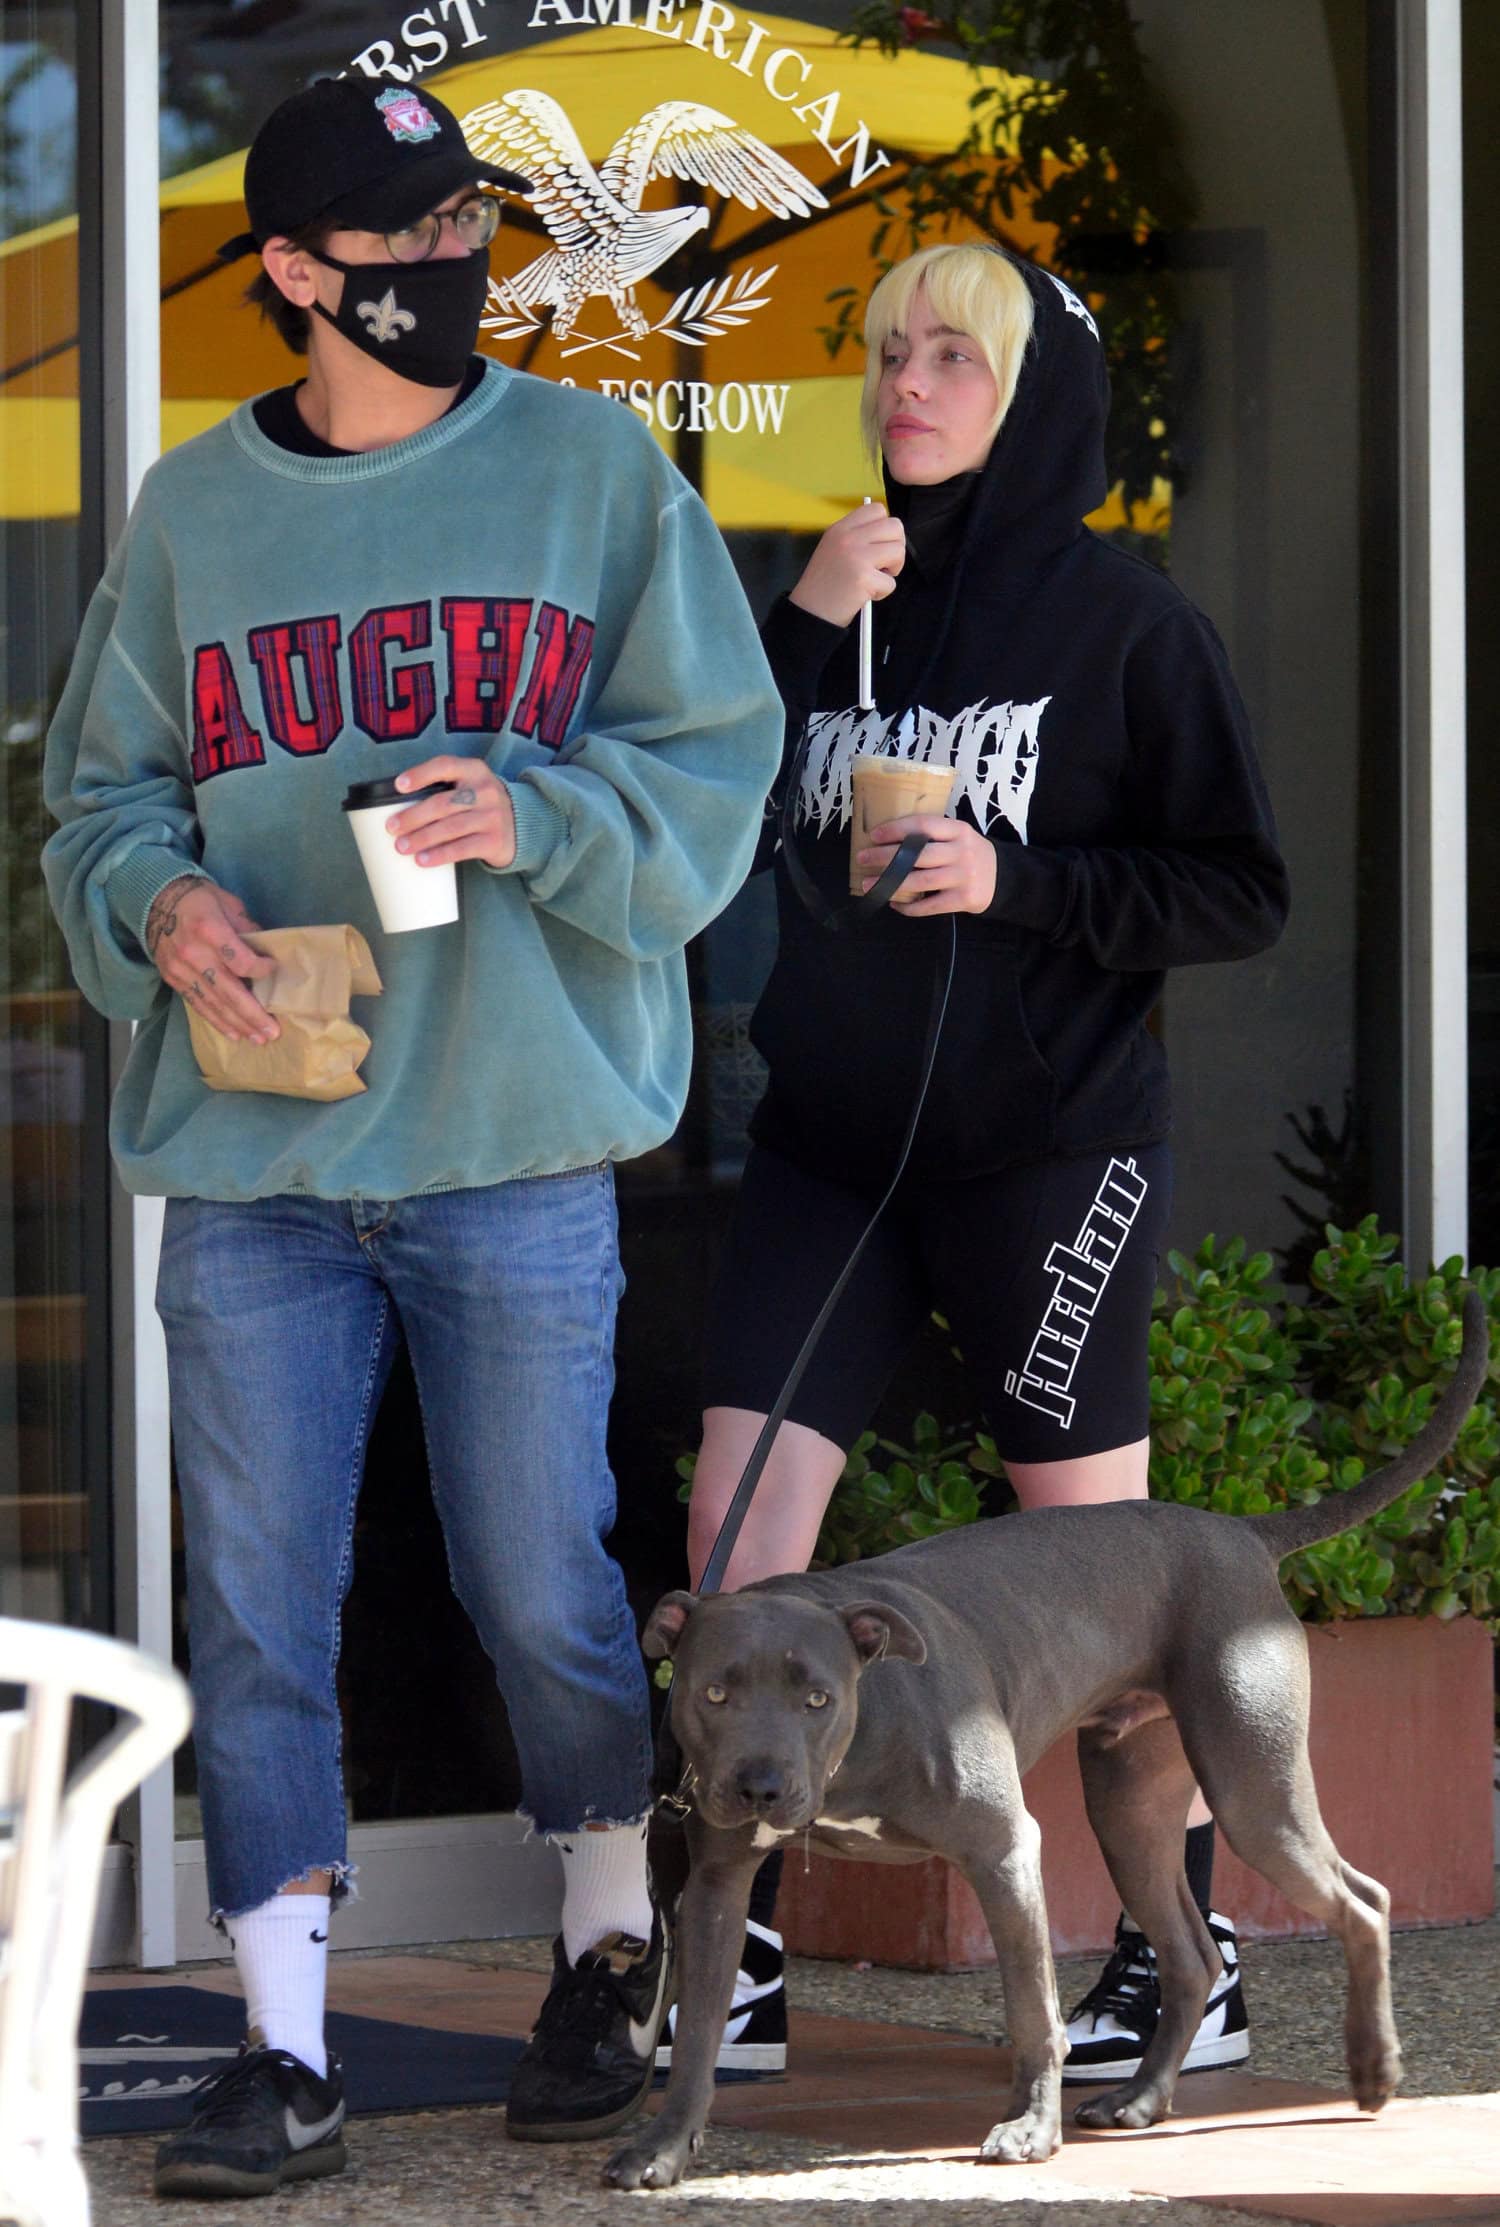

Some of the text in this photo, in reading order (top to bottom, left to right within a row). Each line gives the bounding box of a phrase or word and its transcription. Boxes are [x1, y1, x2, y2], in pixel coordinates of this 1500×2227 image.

[336, 0, 892, 189] RST AMERICAN
[191, 596, 597, 786] AUGHN
